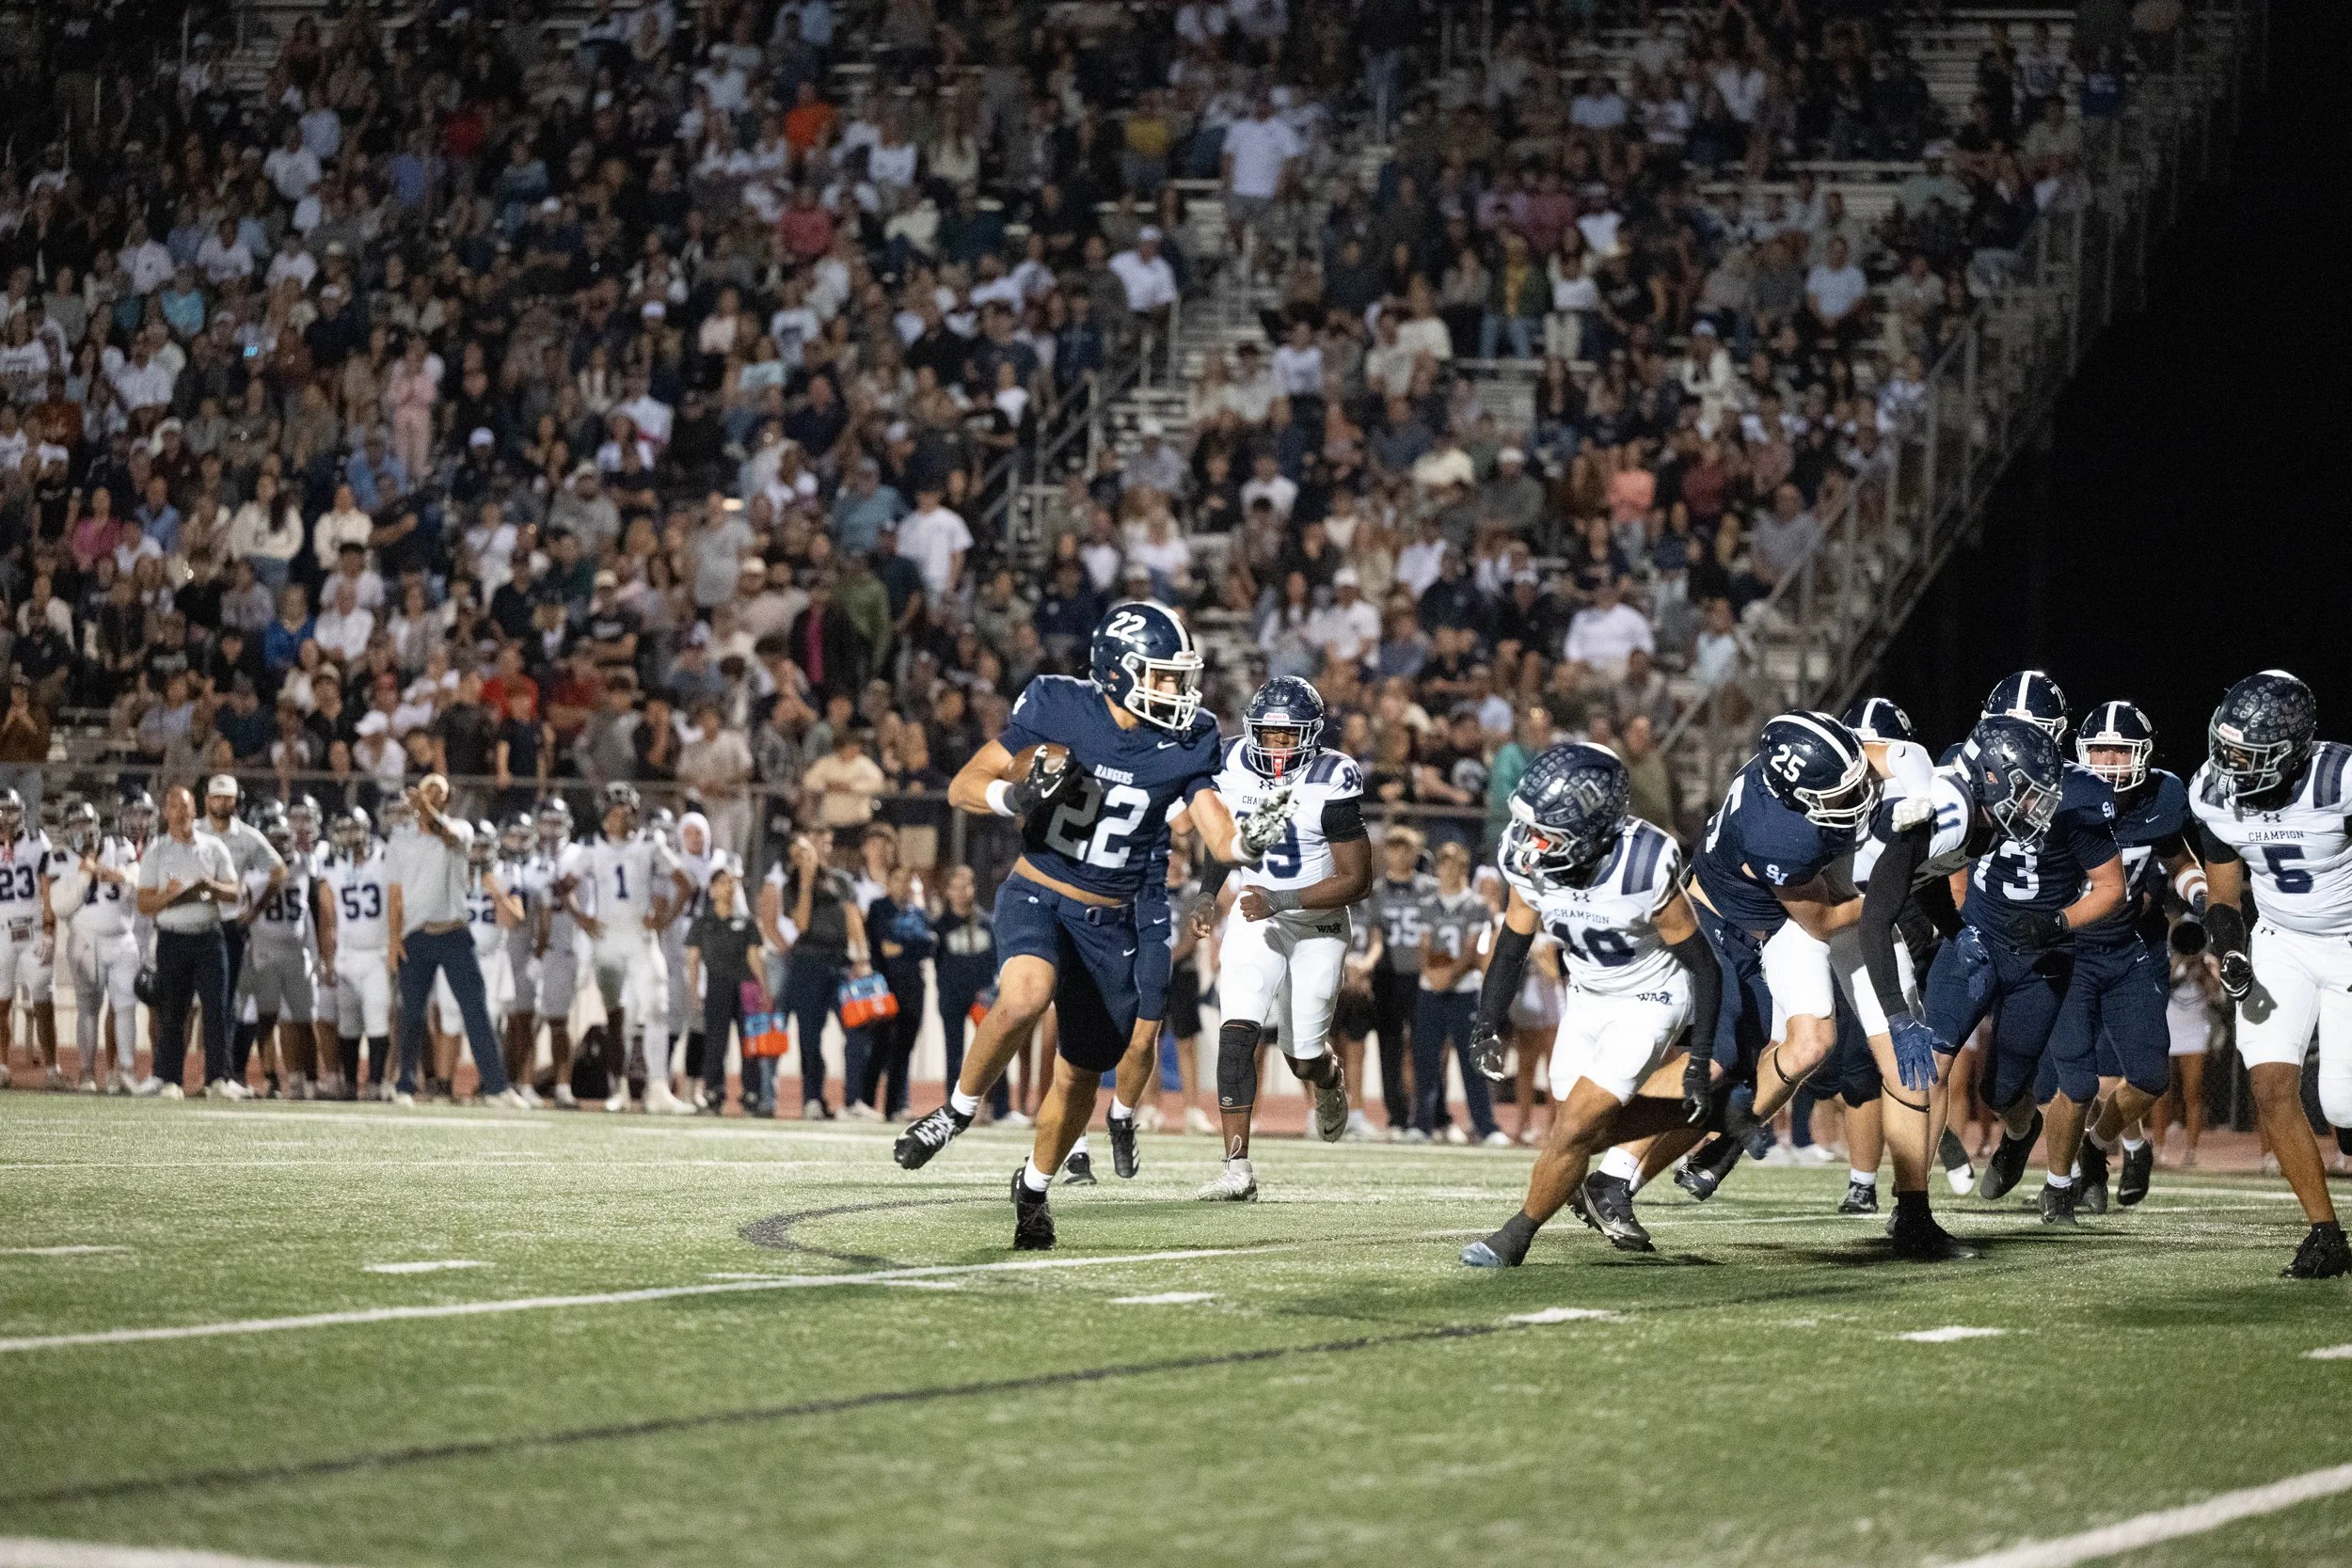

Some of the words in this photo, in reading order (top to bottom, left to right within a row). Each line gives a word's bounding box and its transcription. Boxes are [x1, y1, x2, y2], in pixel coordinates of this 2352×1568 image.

[1105, 611, 1147, 644] 22
[1094, 764, 1134, 785] RANGERS
[1770, 744, 1807, 783] 25
[1044, 775, 1151, 868] 22
[2249, 831, 2305, 842] CHAMPION
[0, 866, 35, 900] 23
[1766, 863, 1788, 886] SV
[2261, 847, 2313, 894] 5
[342, 883, 381, 919] 53
[1553, 909, 1610, 925] CHAMPION
